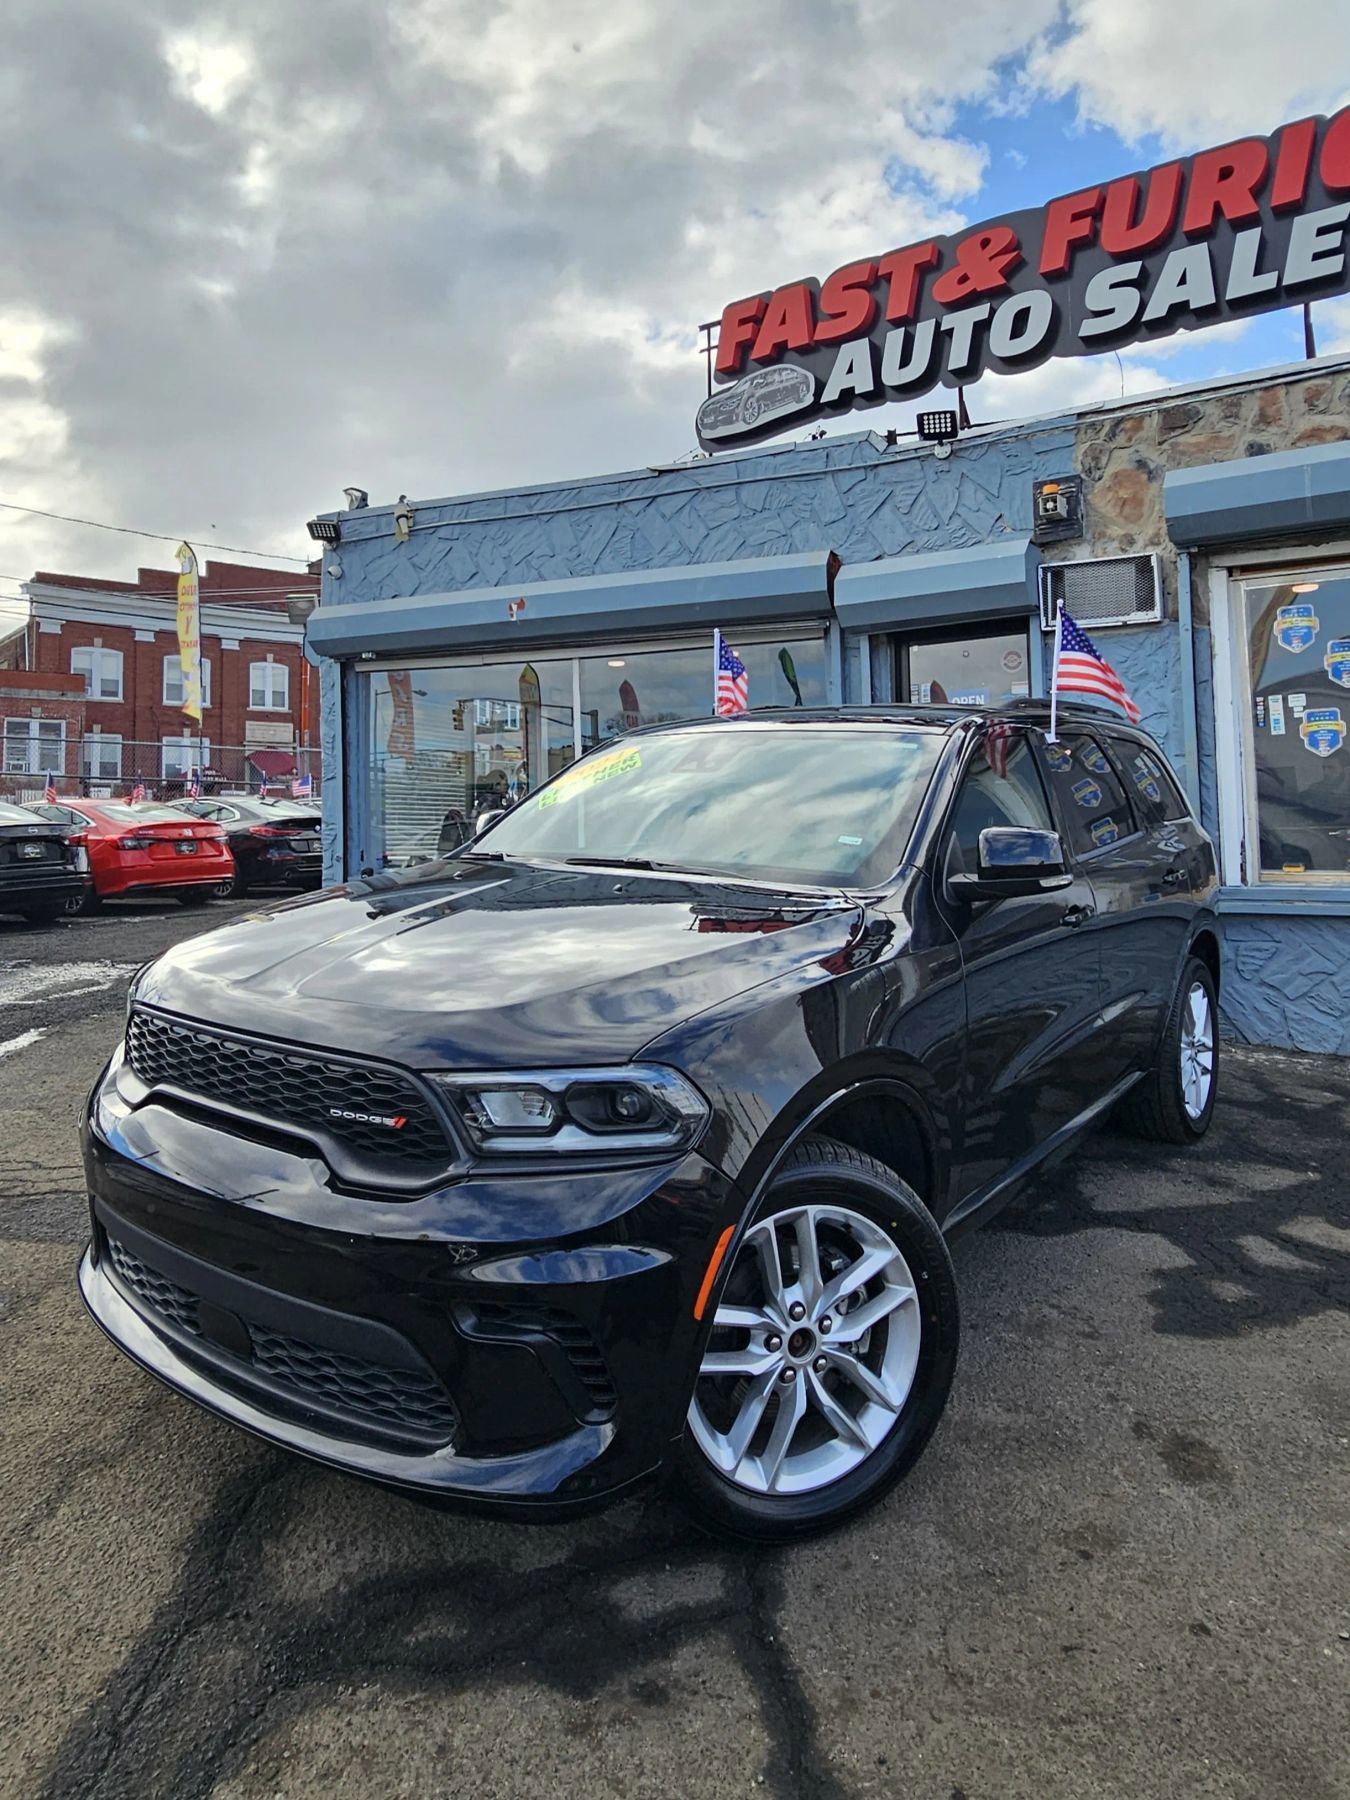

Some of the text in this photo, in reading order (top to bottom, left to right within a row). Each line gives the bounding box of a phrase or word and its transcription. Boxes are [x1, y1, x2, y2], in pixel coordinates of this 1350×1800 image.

[716, 240, 940, 372] FAST
[819, 202, 1350, 403] AUTO SALE
[951, 694, 985, 705] OPEN
[329, 1108, 397, 1127] DODGE
